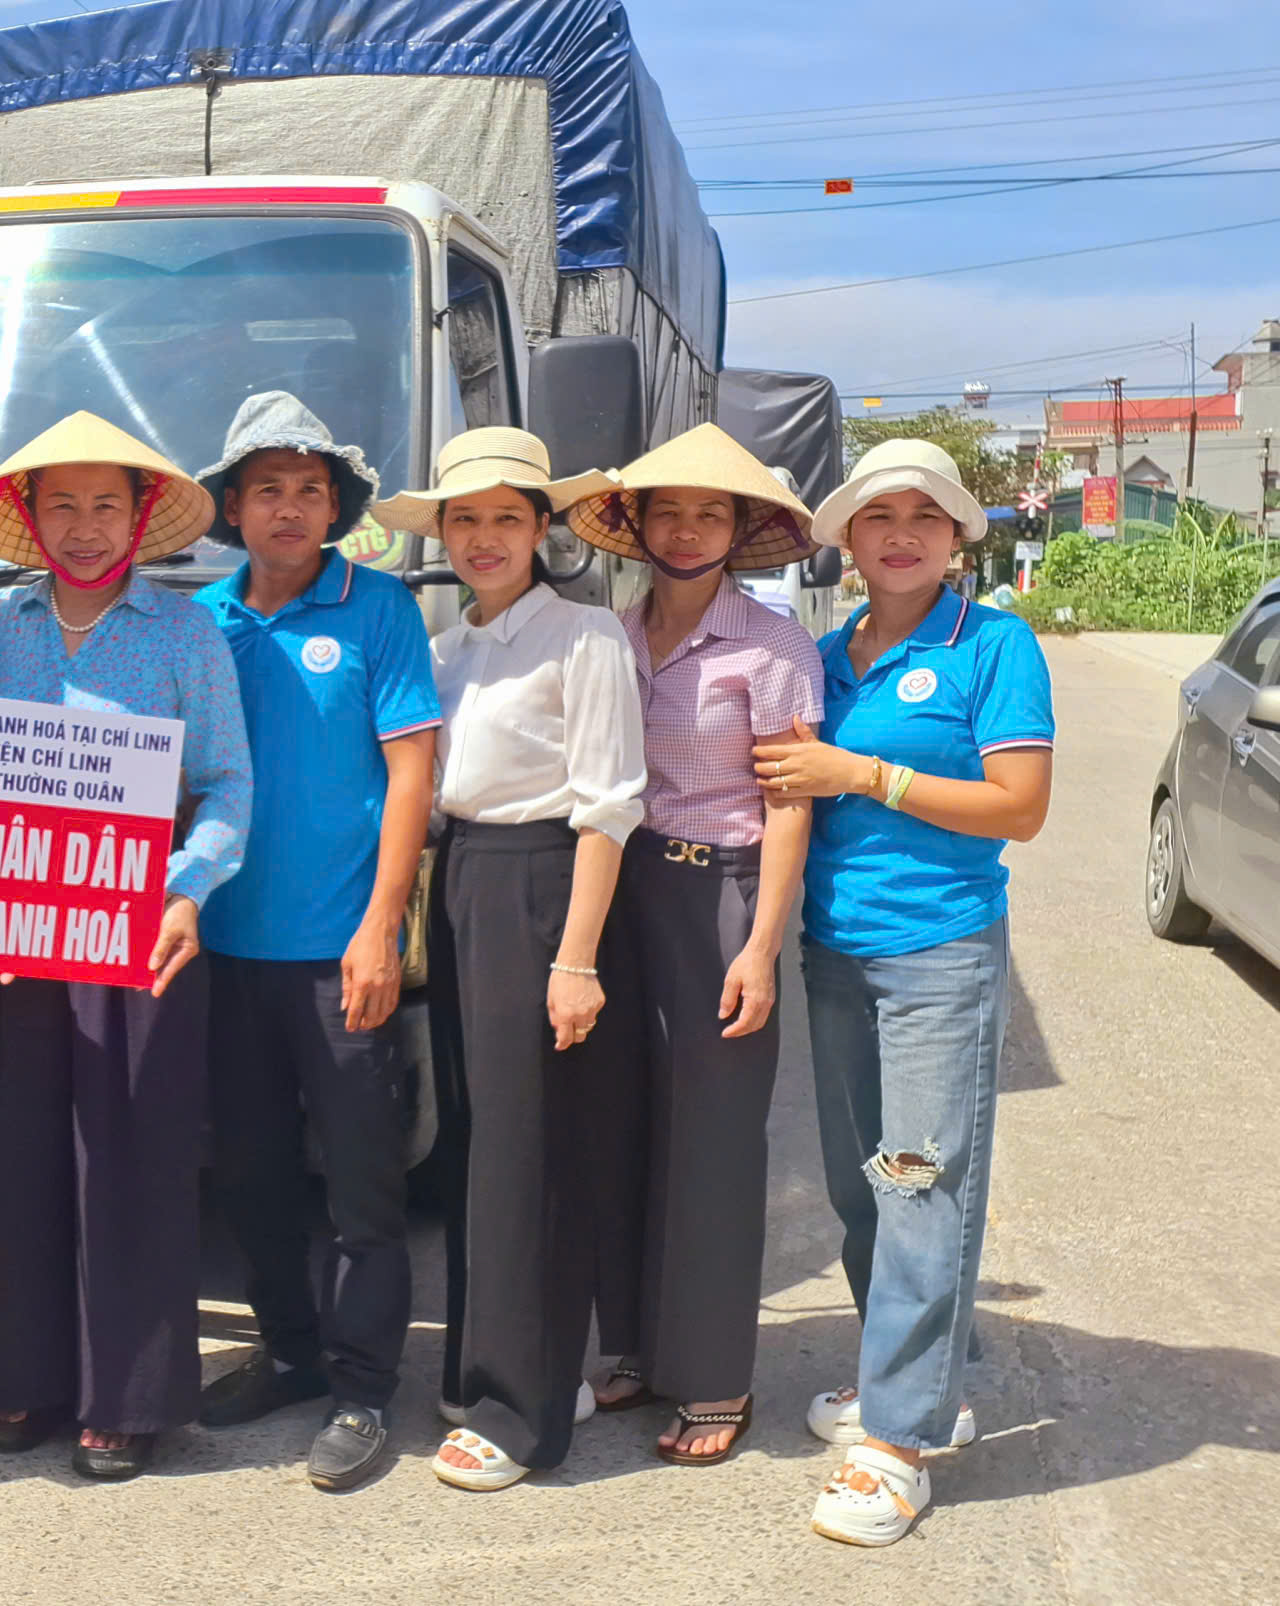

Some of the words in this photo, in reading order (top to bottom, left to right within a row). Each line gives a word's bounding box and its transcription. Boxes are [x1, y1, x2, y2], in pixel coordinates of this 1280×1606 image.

[32, 717, 66, 741] HOÁ
[71, 724, 97, 747] TẠI
[101, 724, 130, 748] CHÍ
[133, 732, 172, 753] LINH
[31, 743, 63, 768] CHÍ
[68, 752, 112, 774] LINH
[73, 780, 125, 803] QUÂN
[63, 824, 150, 893] DÂN
[62, 901, 130, 966] HOÁ
